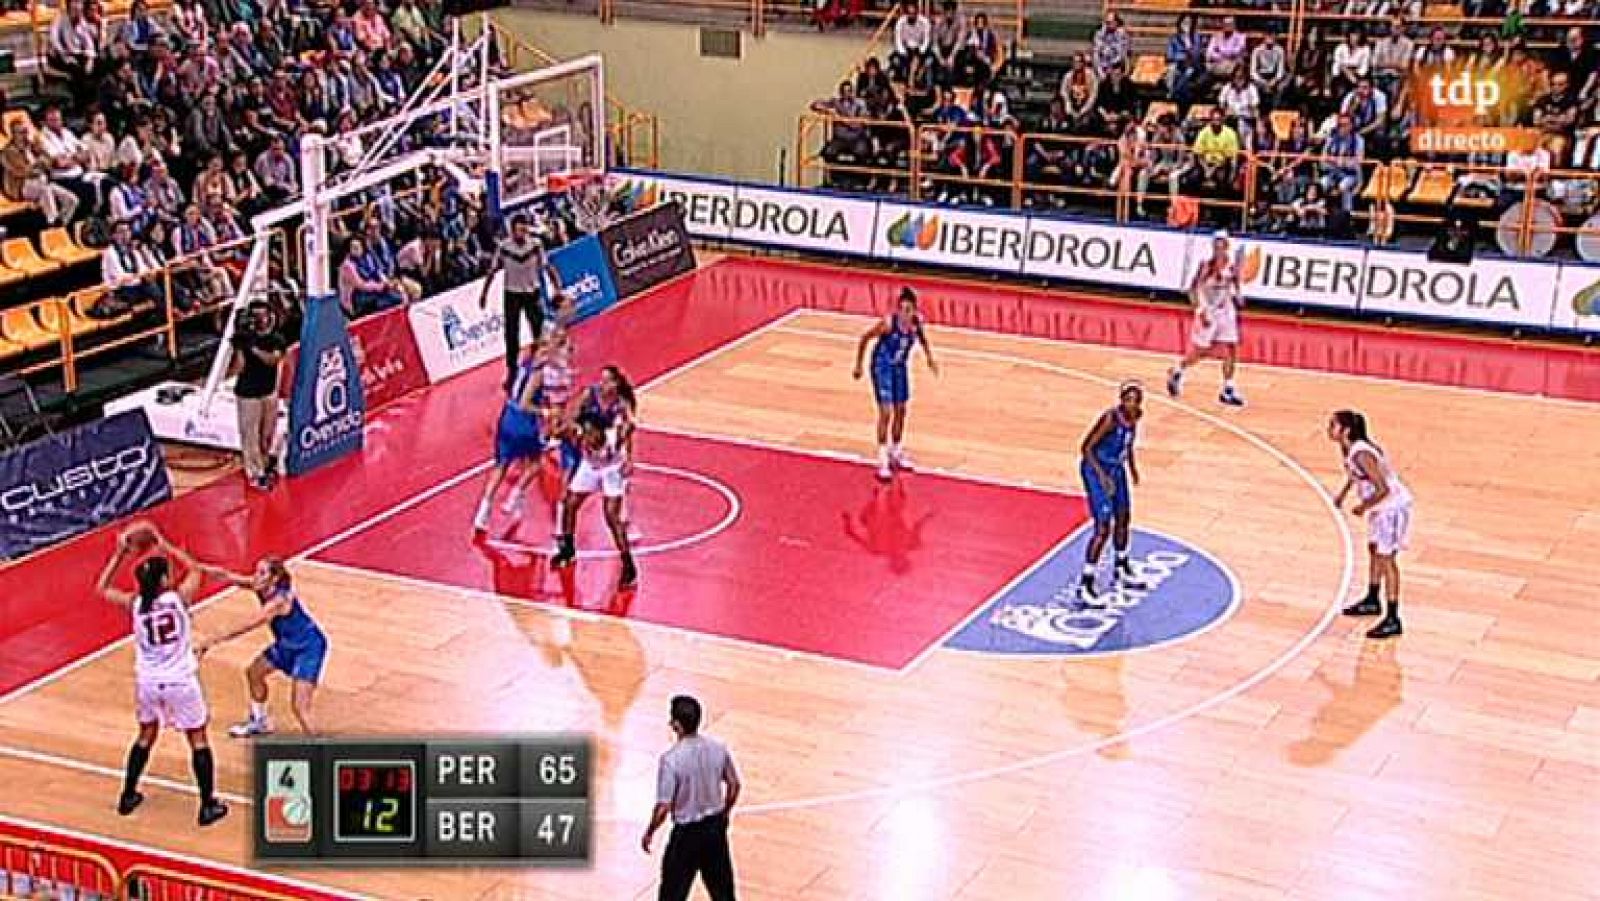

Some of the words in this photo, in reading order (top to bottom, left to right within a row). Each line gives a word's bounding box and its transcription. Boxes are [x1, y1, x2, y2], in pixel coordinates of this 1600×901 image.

[938, 222, 1157, 275] IBERDROLA
[1261, 253, 1519, 310] IBERDROLA
[143, 613, 178, 645] 12
